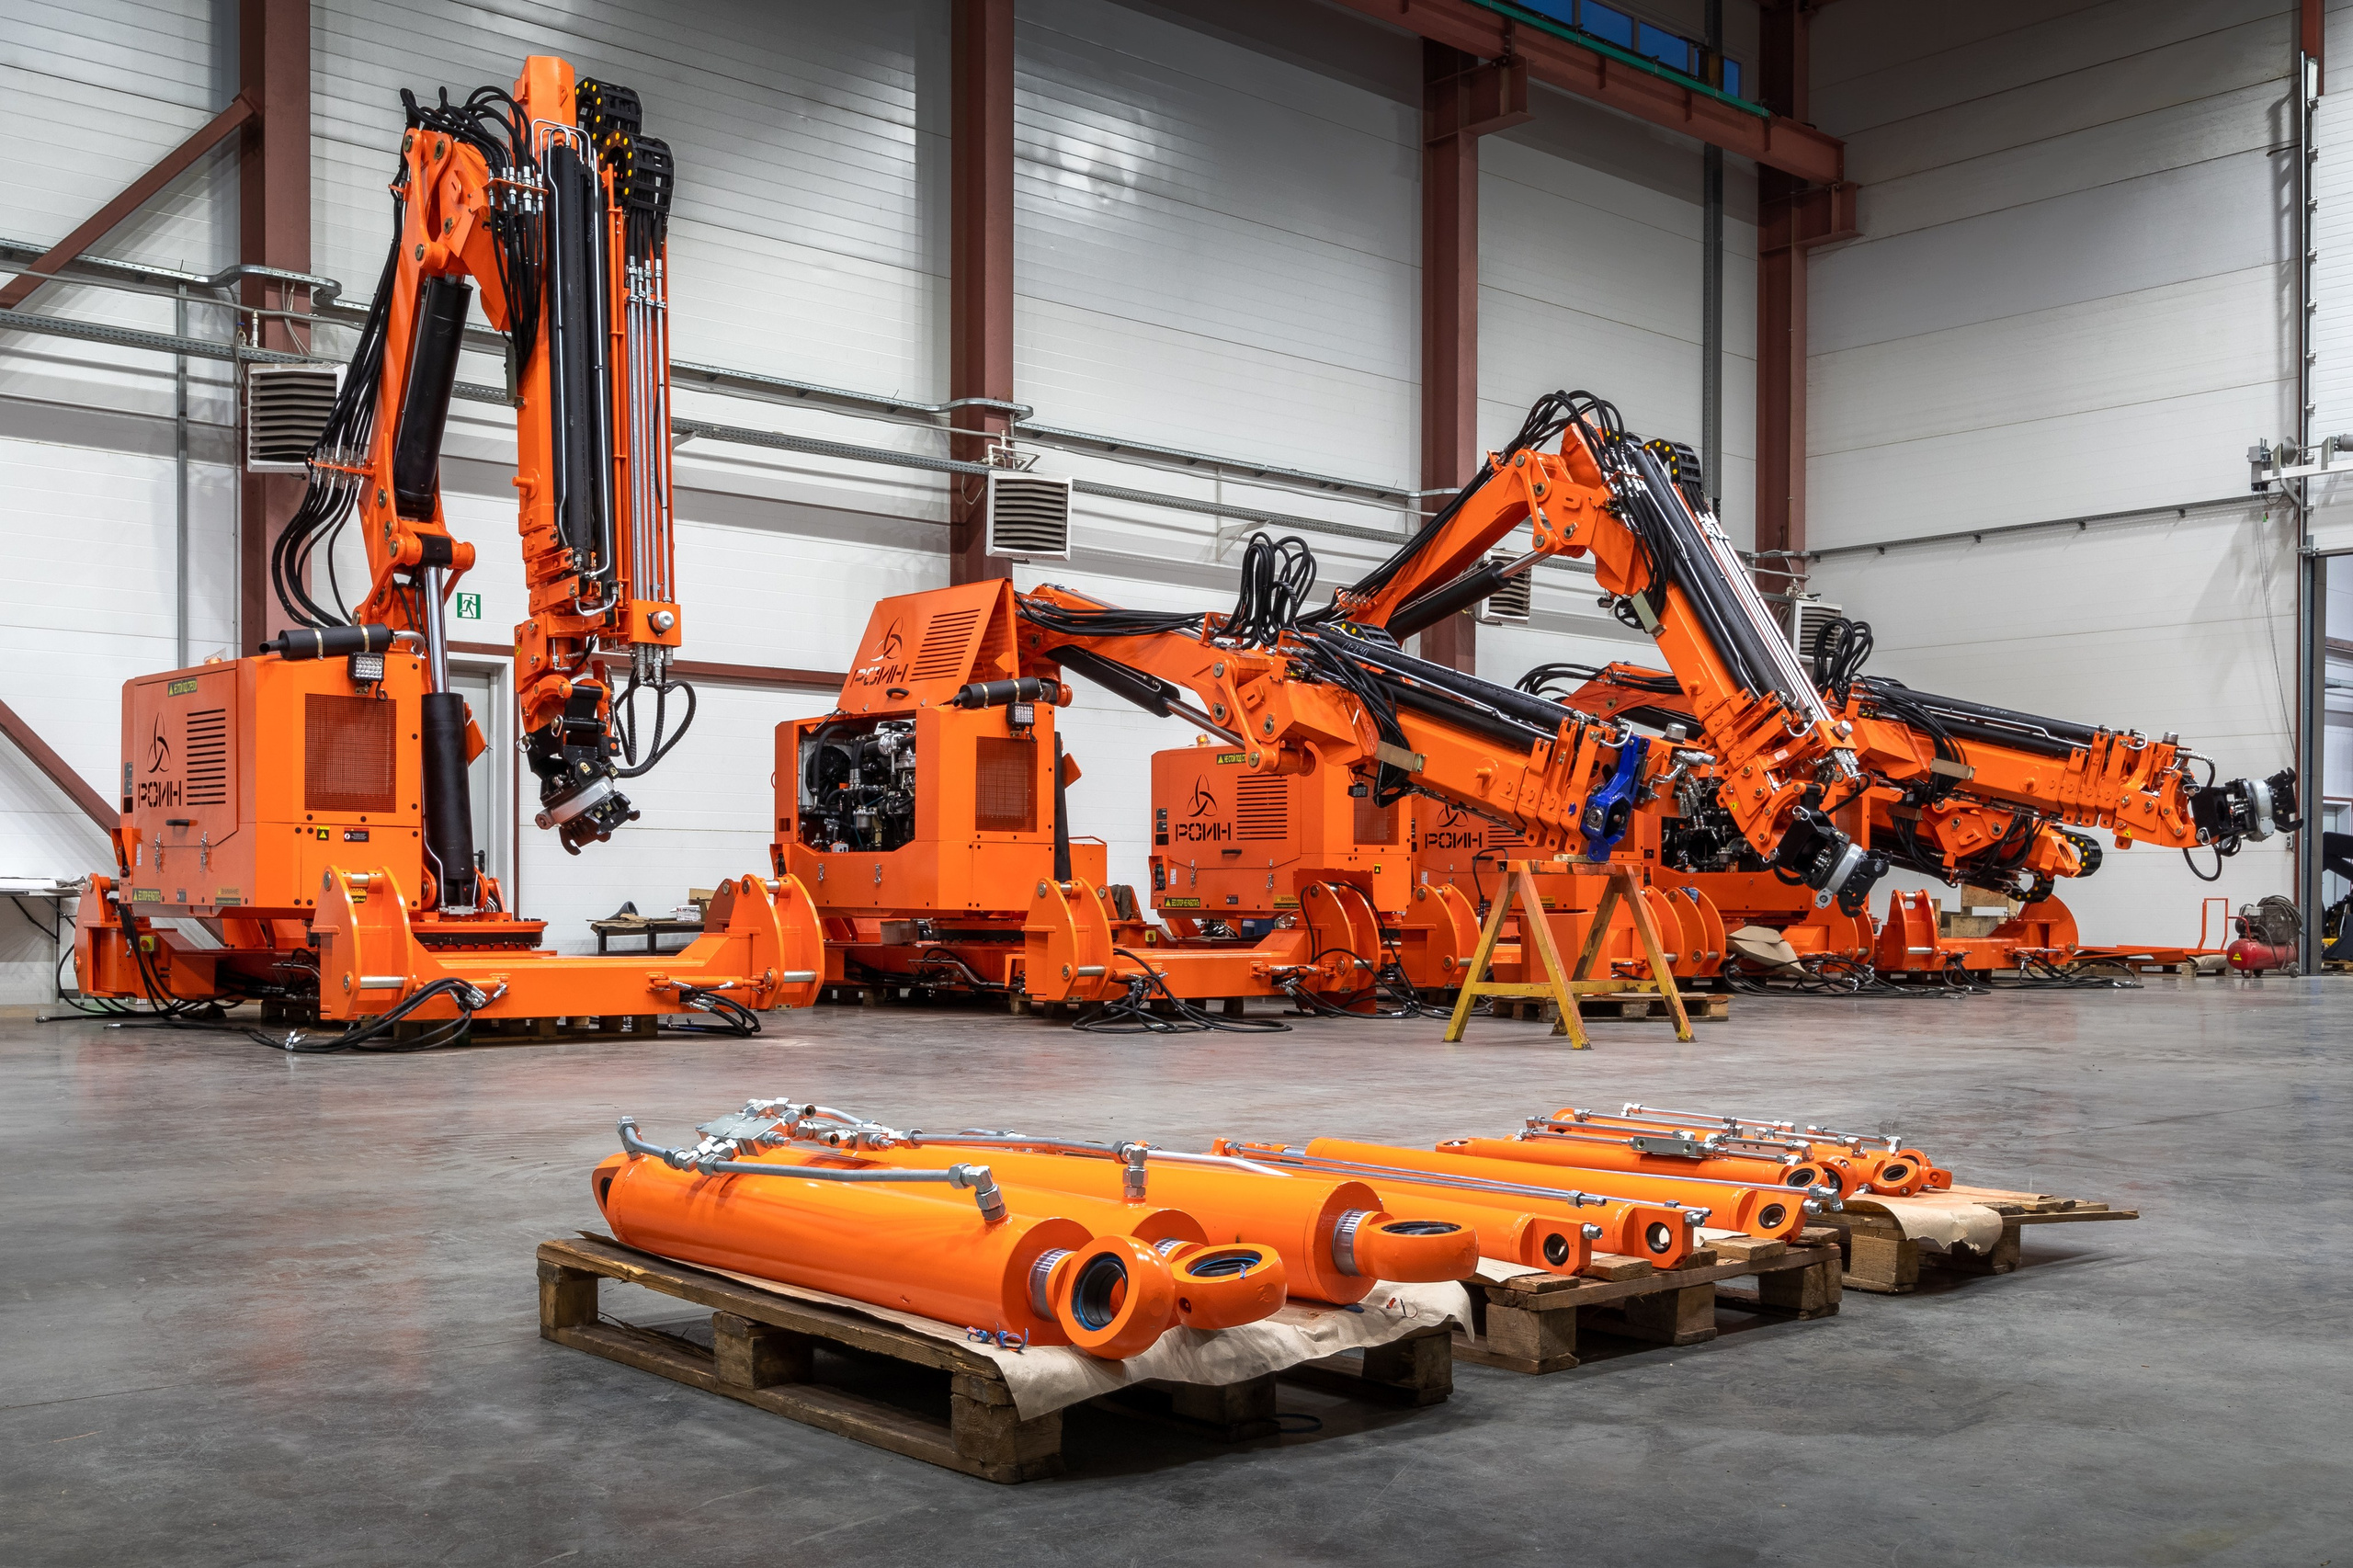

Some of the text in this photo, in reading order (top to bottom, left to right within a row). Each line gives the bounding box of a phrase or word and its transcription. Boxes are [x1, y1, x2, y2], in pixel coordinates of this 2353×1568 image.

[848, 664, 909, 687] РОИН
[138, 780, 181, 808] РОИН
[1176, 823, 1231, 841] РОИН
[1425, 832, 1482, 848] РОИН
